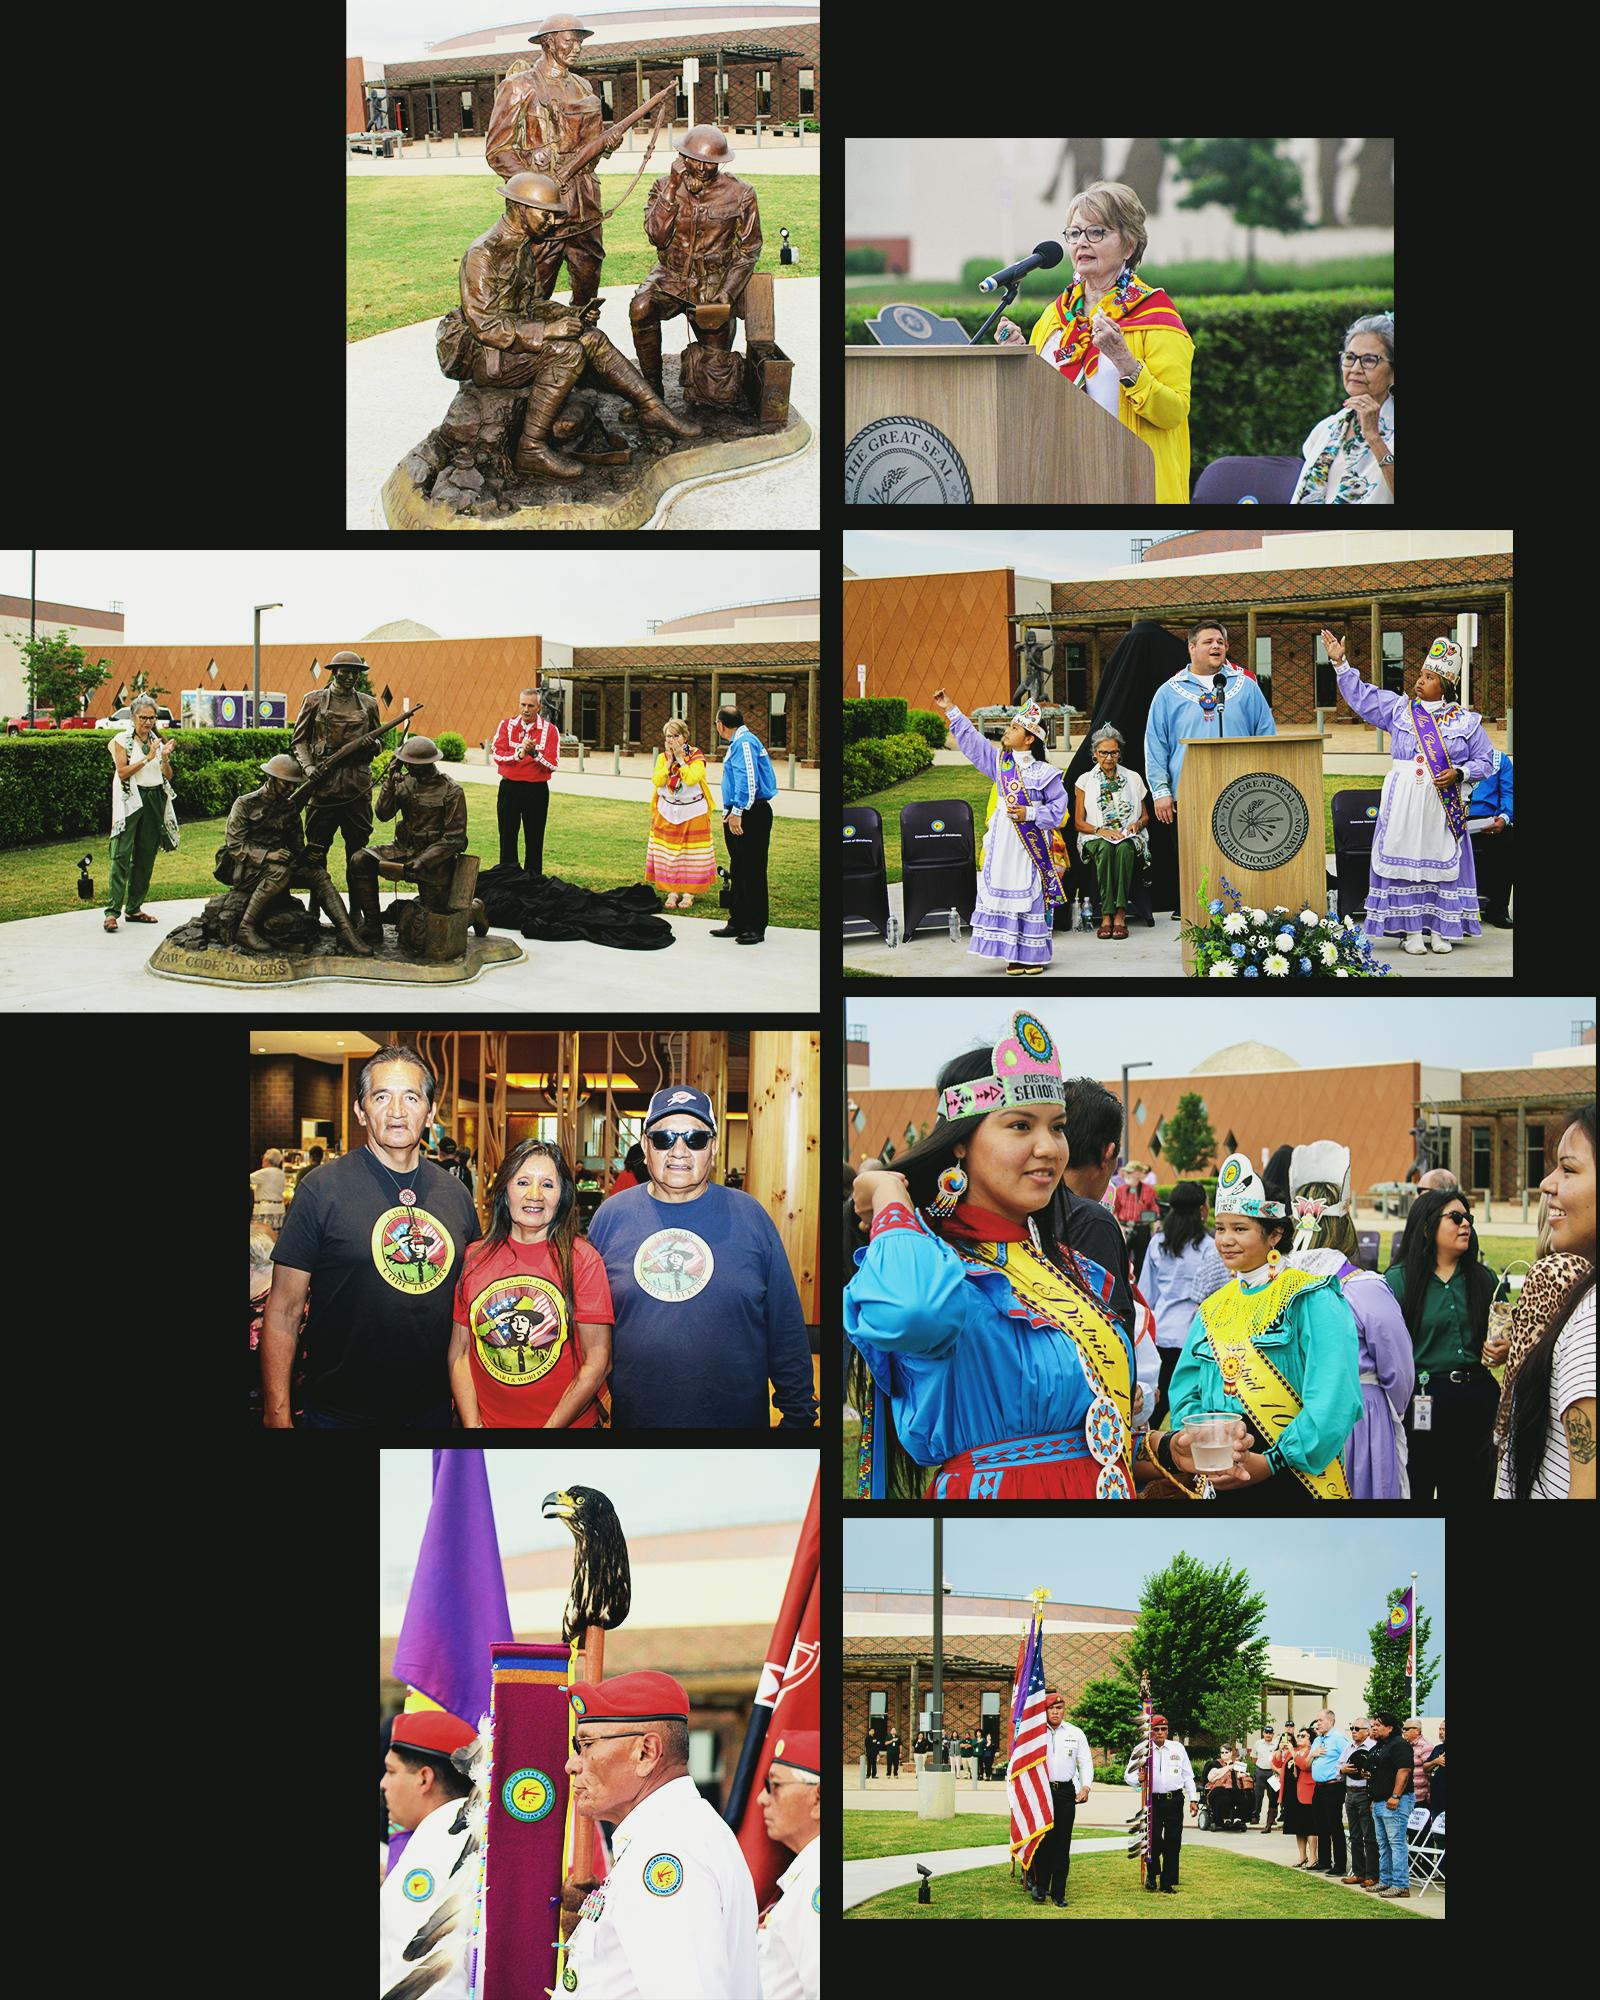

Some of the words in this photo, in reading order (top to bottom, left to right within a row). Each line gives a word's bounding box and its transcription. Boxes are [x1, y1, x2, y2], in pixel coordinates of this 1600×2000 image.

[846, 449, 867, 484] THE
[868, 430, 921, 452] GREAT
[921, 440, 953, 482] SEAL
[1222, 790, 1239, 811] THE
[1237, 780, 1274, 793] GREAT
[1274, 784, 1296, 806] SEAL
[1219, 824, 1228, 836] OF
[1224, 835, 1240, 857] THE
[1240, 849, 1285, 864] CHOCTAW
[1284, 817, 1303, 853] NATION
[186, 956, 220, 970] CODE
[225, 962, 287, 976] TALKERS
[1014, 1084, 1056, 1102] SENIOR
[383, 1267, 406, 1288] CODE
[414, 1268, 447, 1292] TALKERS
[670, 1278, 707, 1299] TALKERS
[1032, 1282, 1115, 1370] District
[1260, 1402, 1295, 1427] 10
